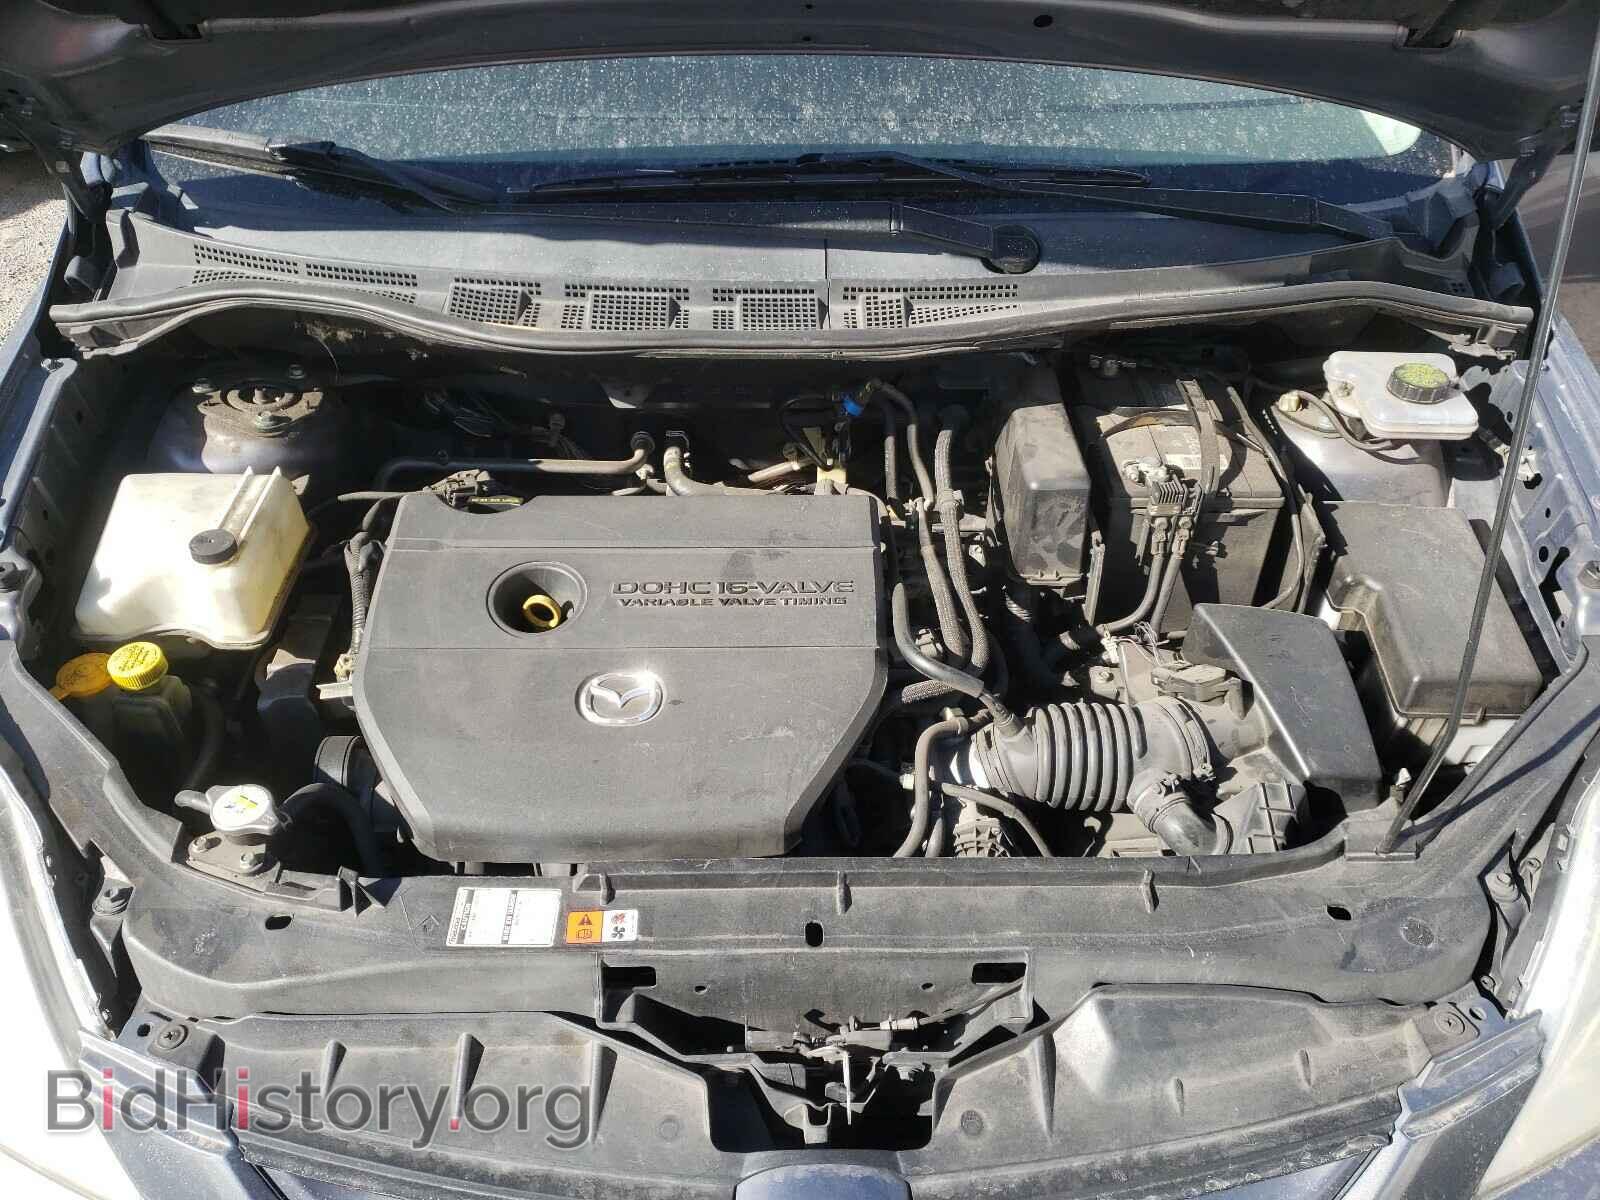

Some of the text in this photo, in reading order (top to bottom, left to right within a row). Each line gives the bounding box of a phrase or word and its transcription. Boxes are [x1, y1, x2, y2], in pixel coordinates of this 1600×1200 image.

[611, 580, 855, 595] DOHC 16-VALVE
[618, 596, 848, 607] VARIABLE VALVE TIMING
